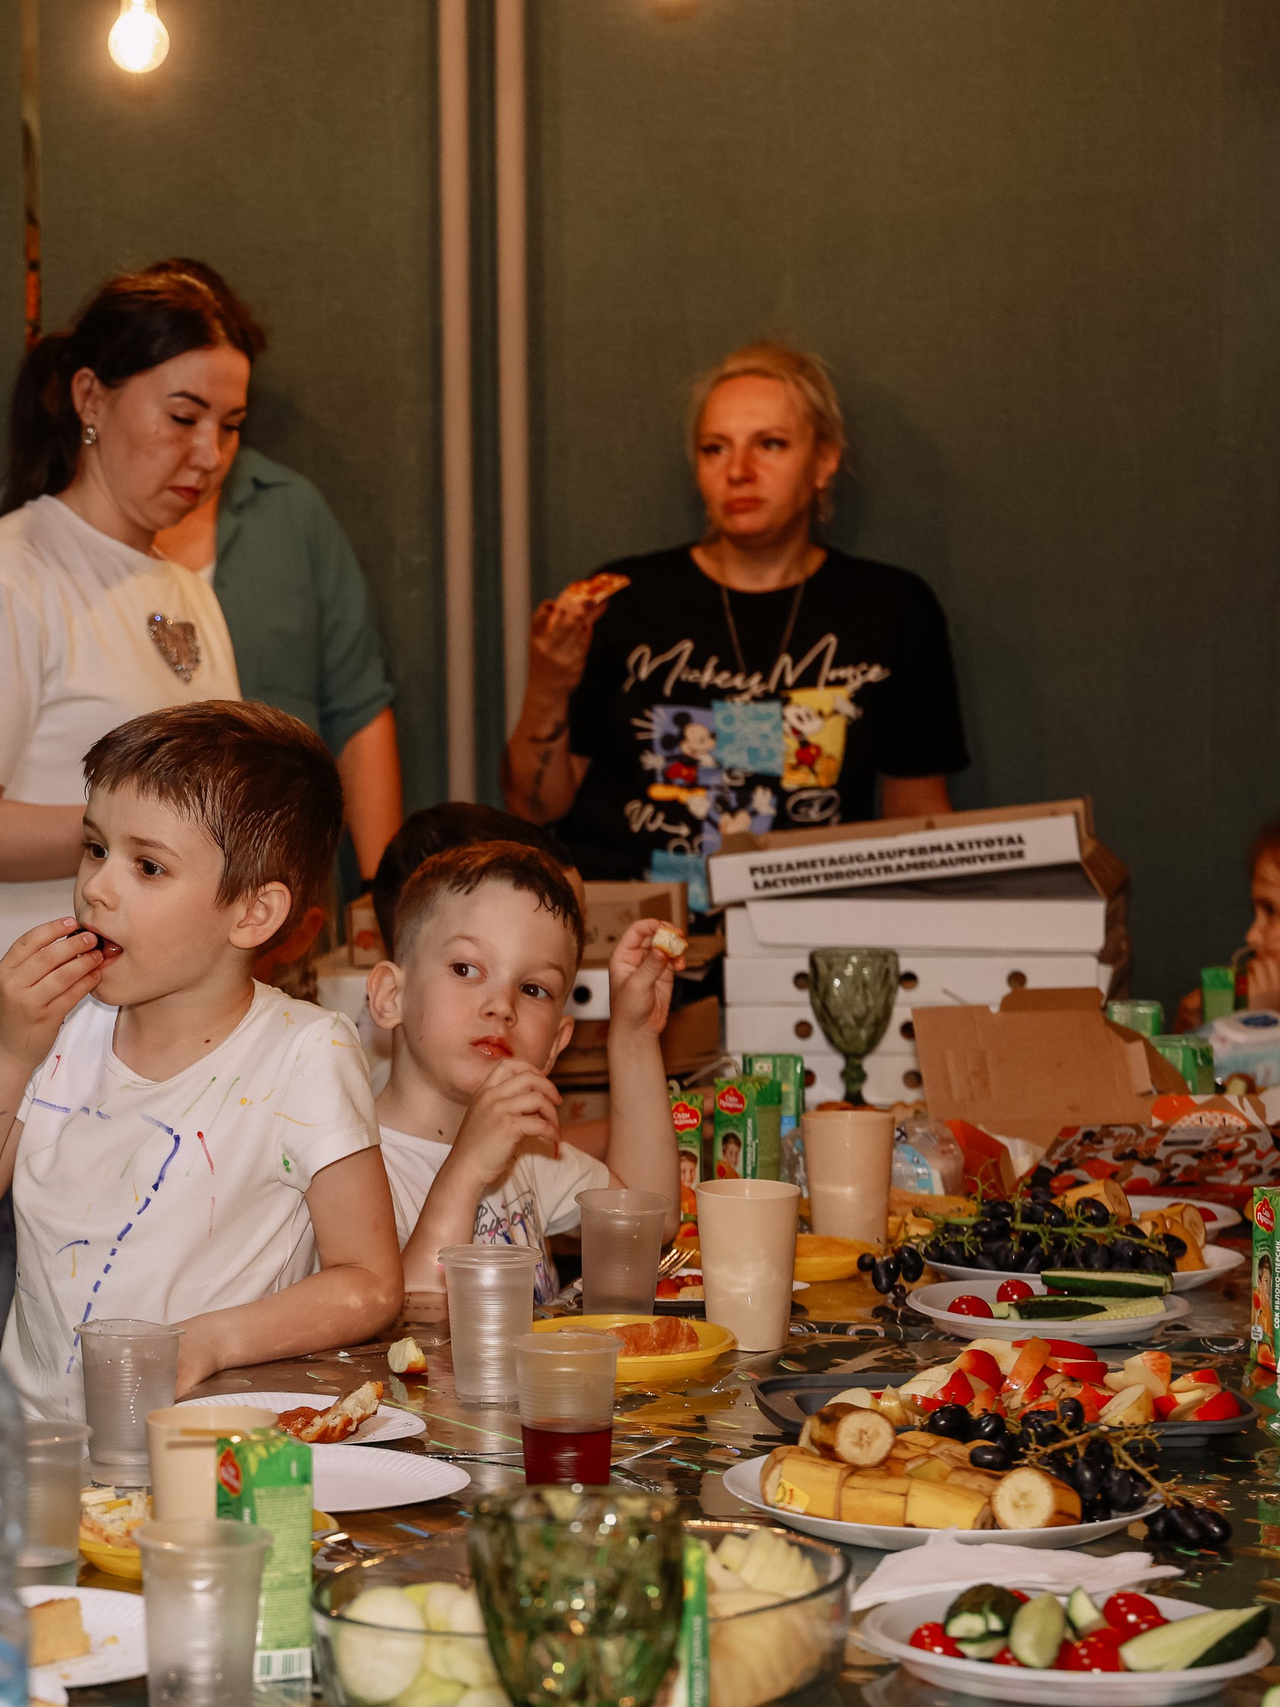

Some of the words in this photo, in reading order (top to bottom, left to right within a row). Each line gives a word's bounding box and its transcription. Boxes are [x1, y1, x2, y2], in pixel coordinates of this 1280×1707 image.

[622, 638, 768, 704] Mickey
[768, 633, 891, 697] Mouse
[673, 1111, 690, 1119] Сады
